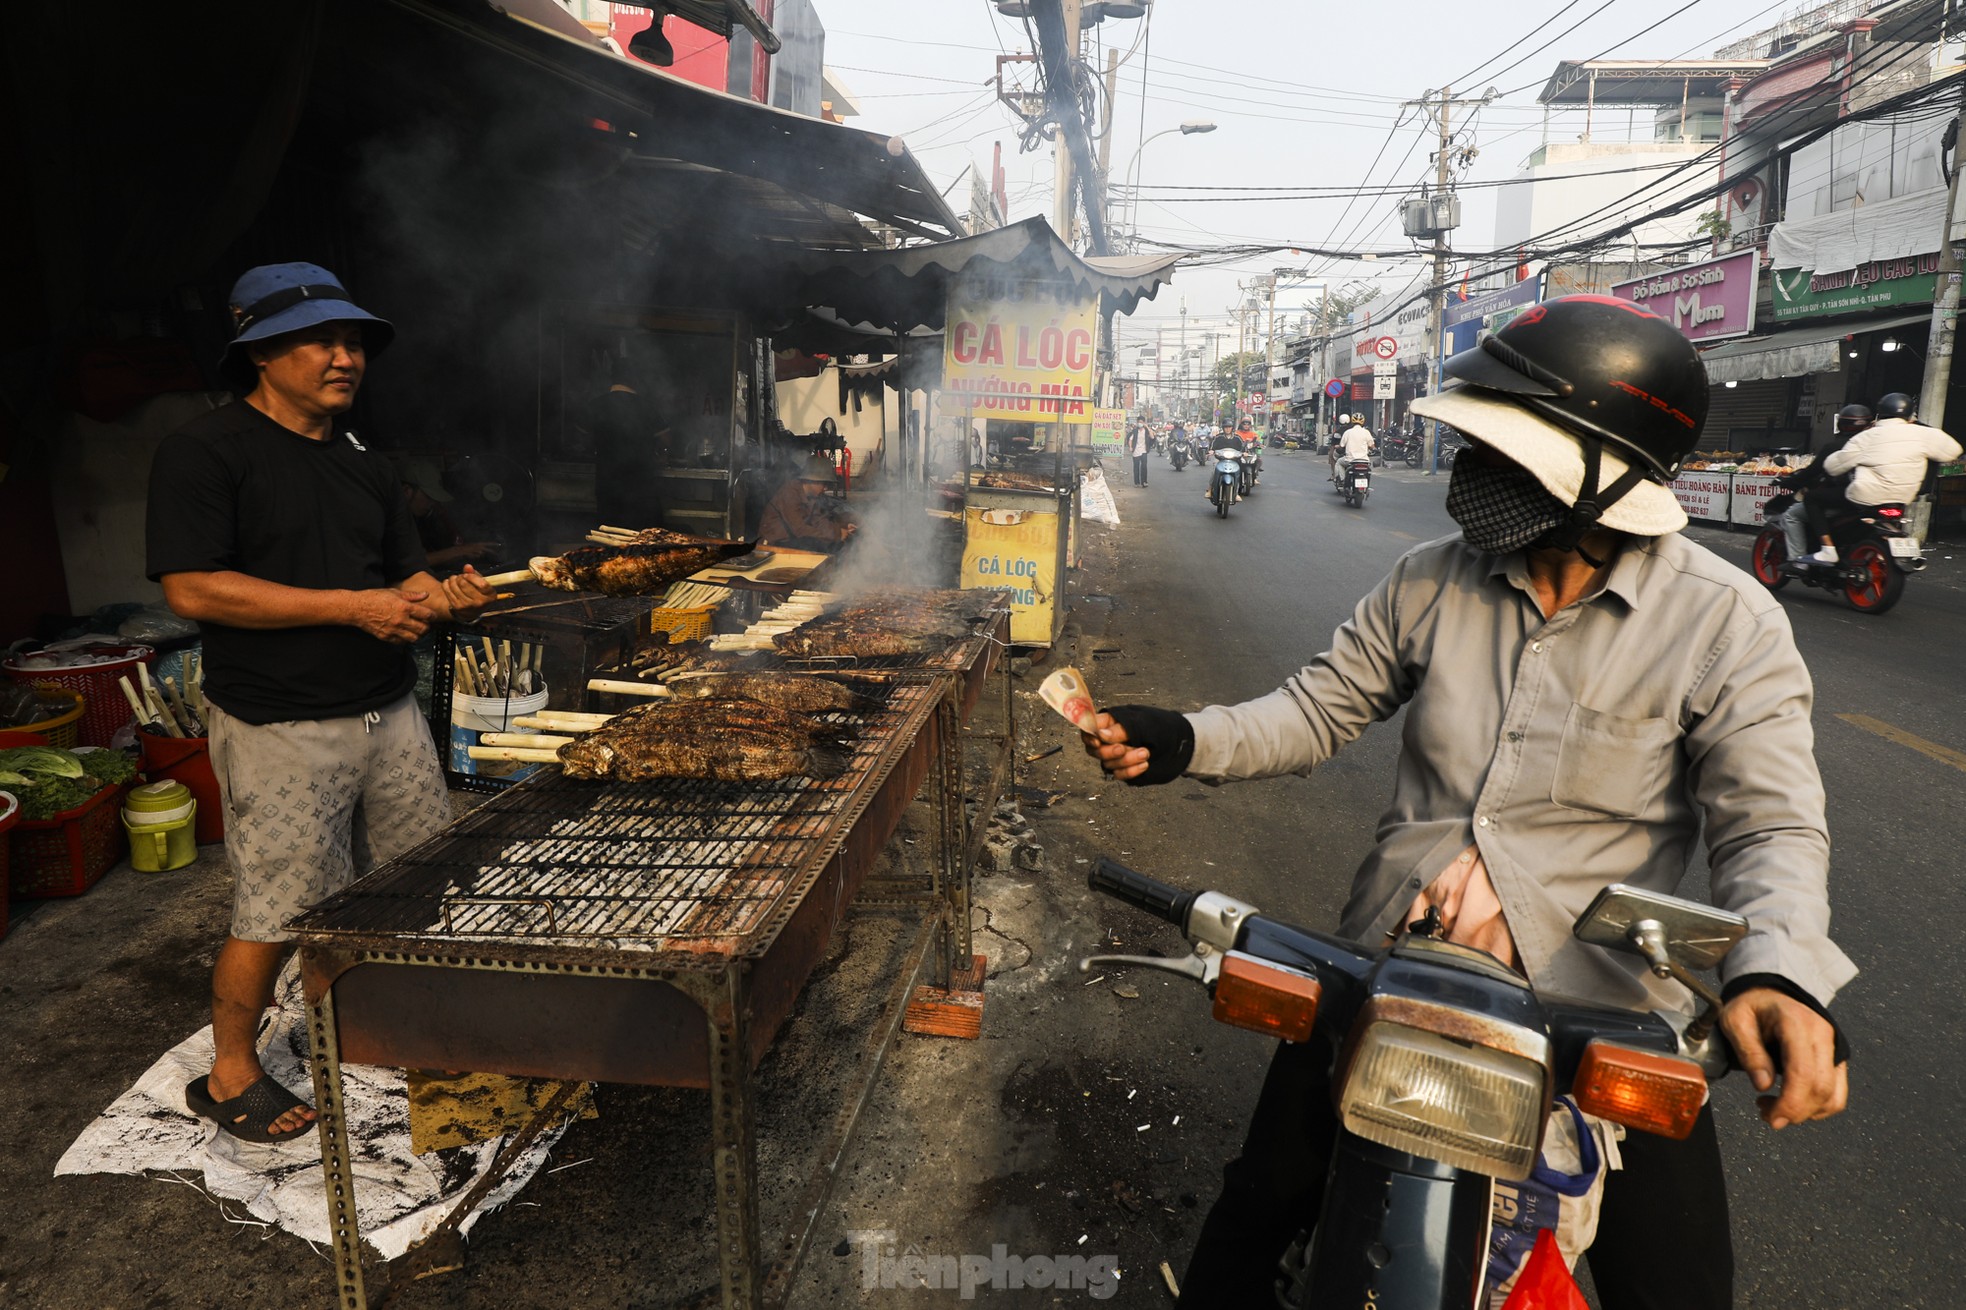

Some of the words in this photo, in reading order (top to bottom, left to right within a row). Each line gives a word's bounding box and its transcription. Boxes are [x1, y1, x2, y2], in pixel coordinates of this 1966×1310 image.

[1671, 277, 1680, 292] &
[1674, 292, 1725, 329] Mum
[953, 315, 1004, 366] CÁ
[1017, 318, 1091, 371] LÓC
[951, 374, 1032, 412] NƯỚNG
[1039, 378, 1085, 415] MÍA
[978, 555, 1000, 574] CÁ
[1005, 557, 1037, 577] LÓC
